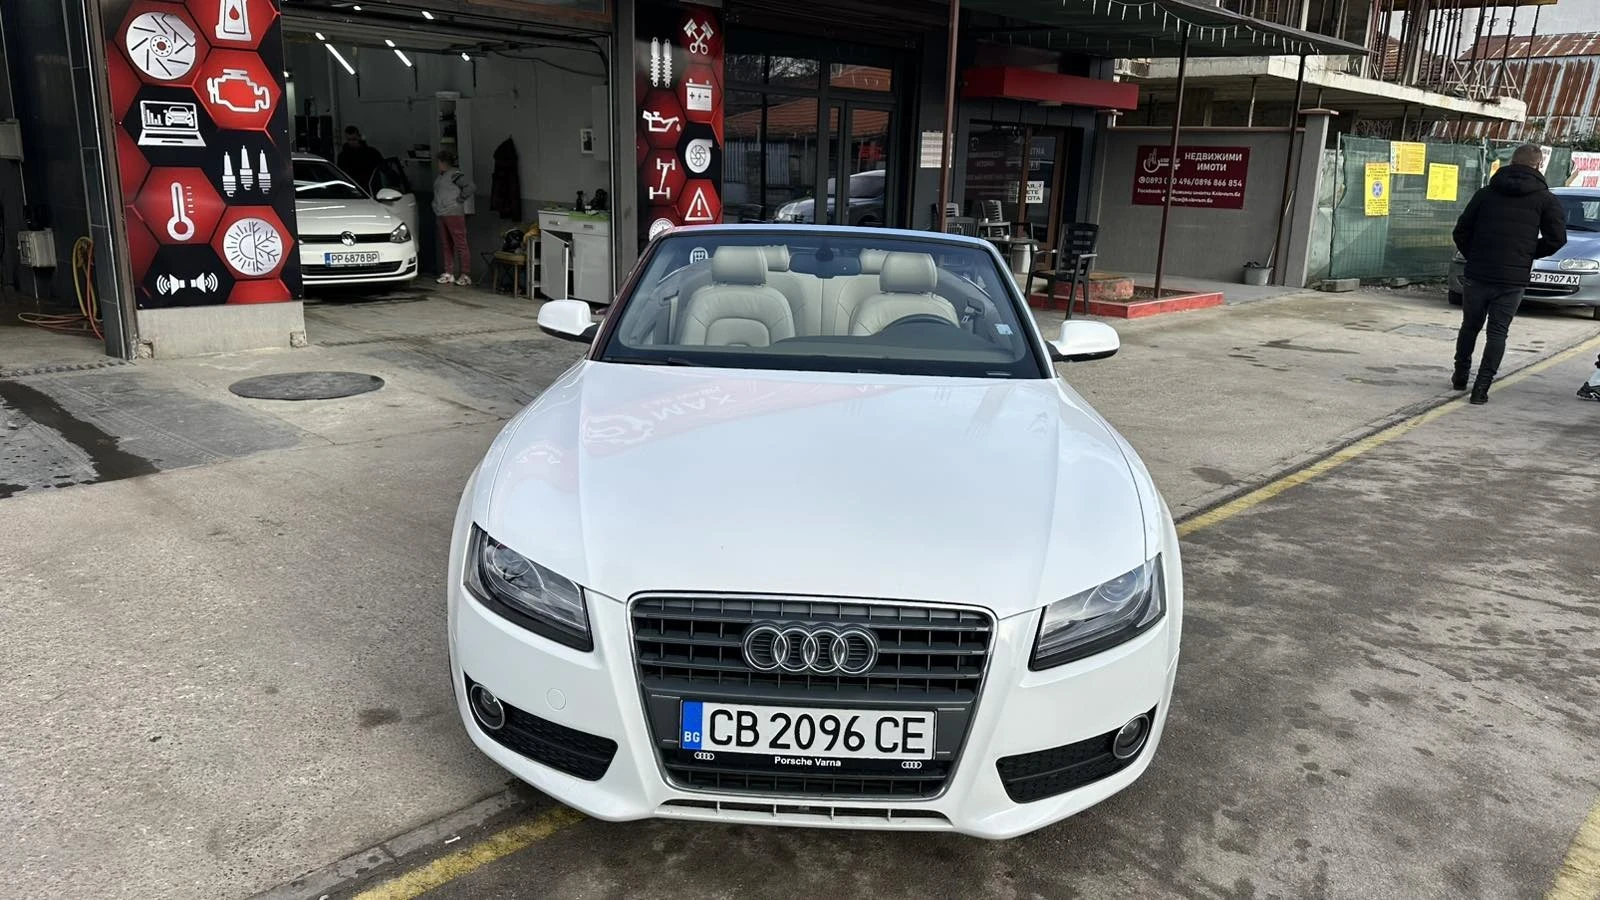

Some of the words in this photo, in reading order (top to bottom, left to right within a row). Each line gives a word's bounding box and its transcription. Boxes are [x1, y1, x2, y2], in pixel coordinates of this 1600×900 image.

[1184, 152, 1243, 162] НЕДВИЖИМИ
[1197, 163, 1227, 171] ИМОТИ
[1145, 176, 1162, 184] 0893
[1213, 179, 1226, 187] 866
[1228, 179, 1242, 187] 854
[345, 254, 365, 263] 6878
[1544, 274, 1565, 283] 1907
[709, 708, 760, 747] CB
[768, 712, 866, 751] 2096
[875, 716, 926, 754] CE
[683, 731, 701, 743] BG
[774, 756, 813, 766] Porsche
[815, 758, 842, 767] Varna
